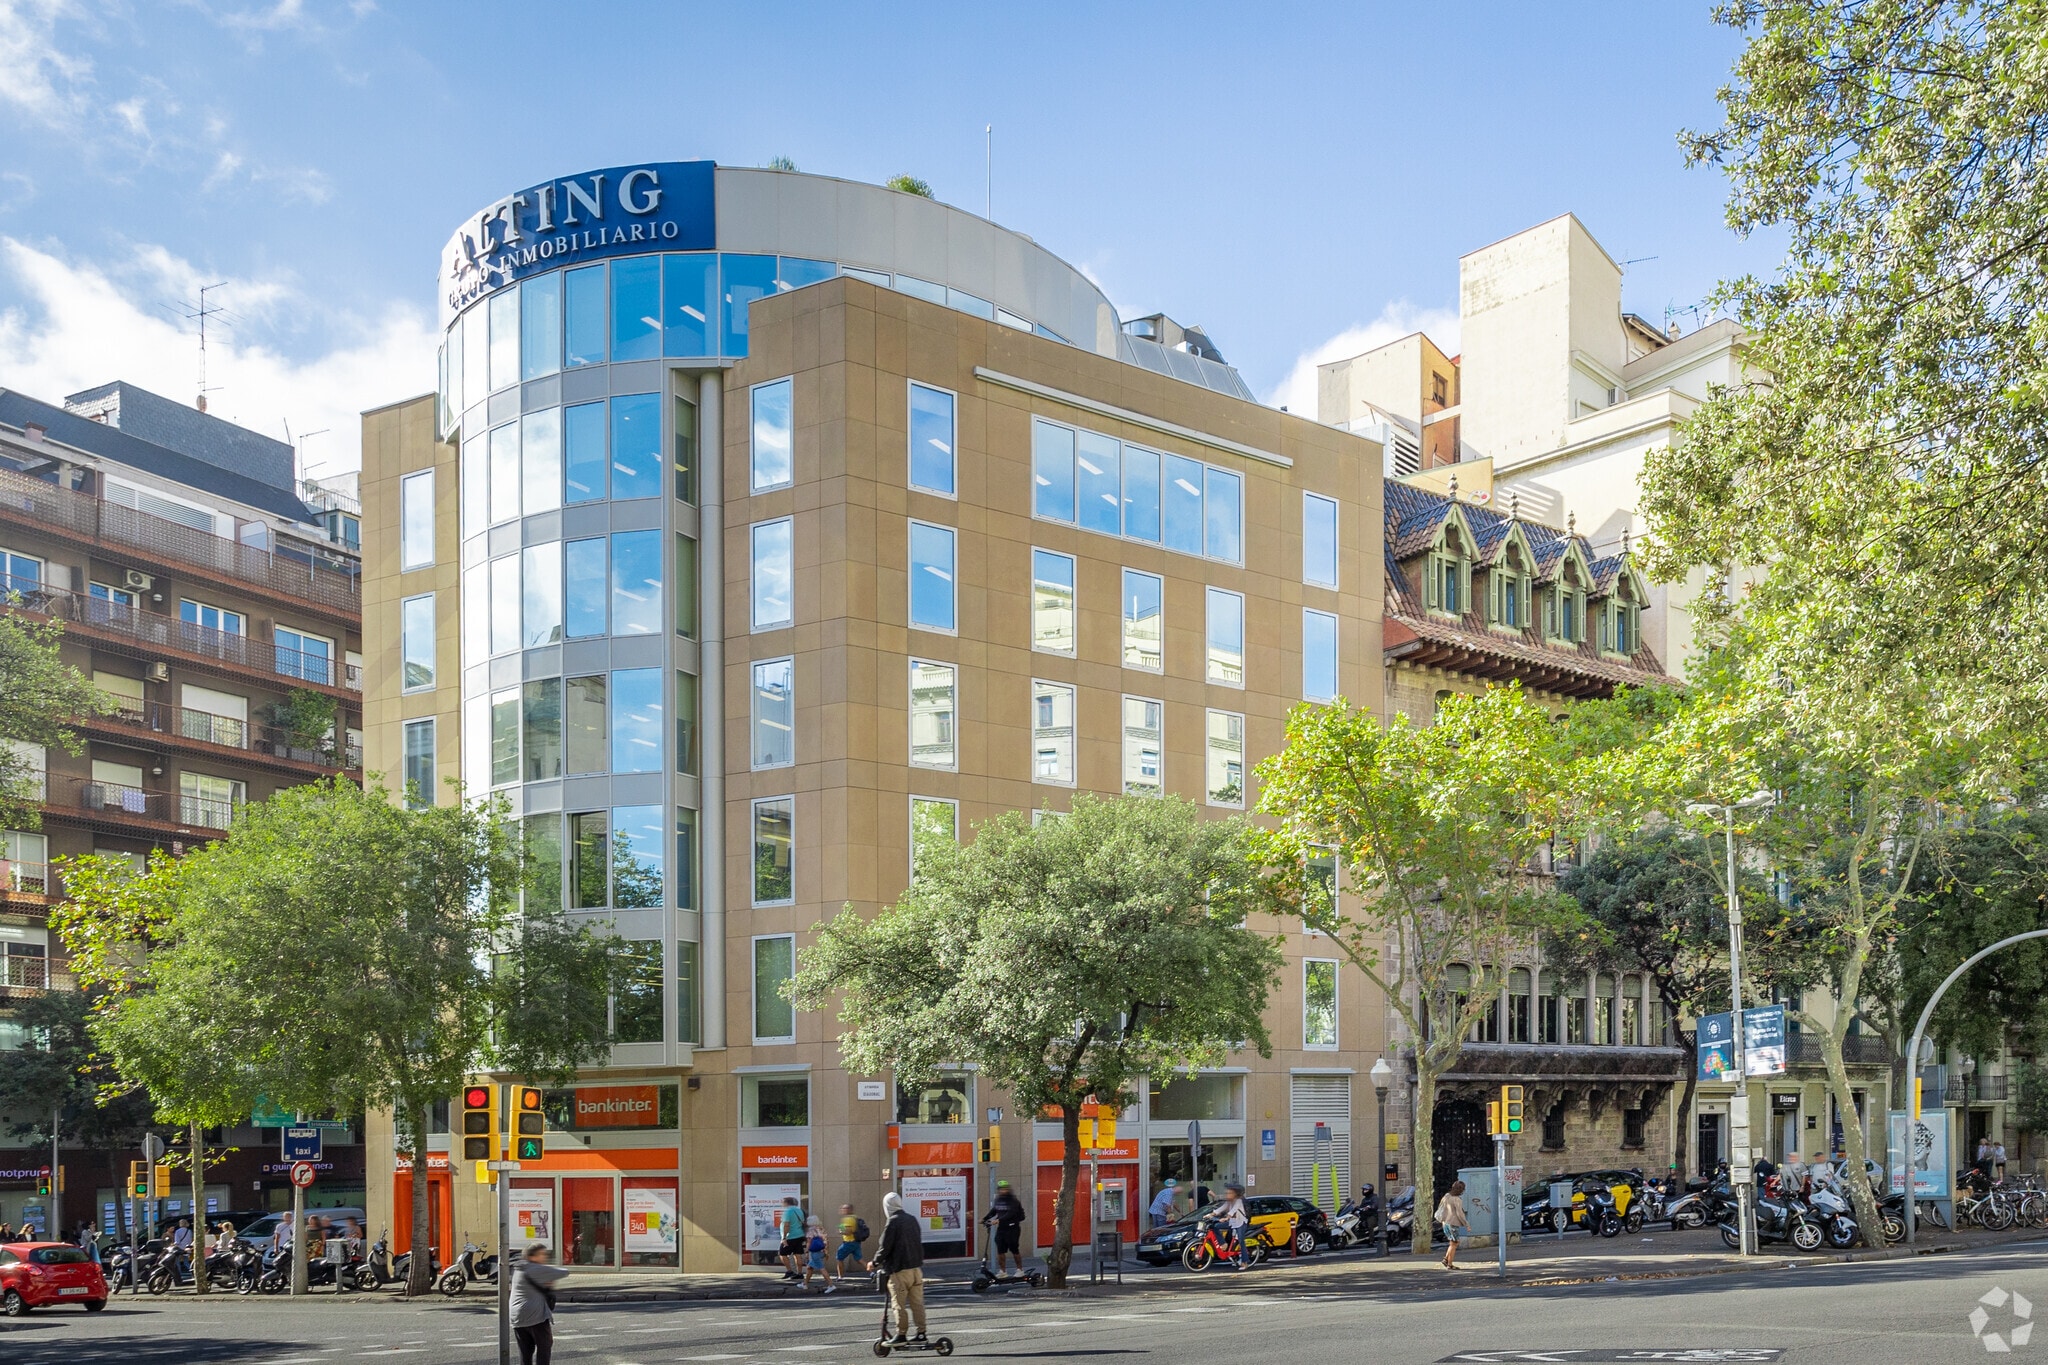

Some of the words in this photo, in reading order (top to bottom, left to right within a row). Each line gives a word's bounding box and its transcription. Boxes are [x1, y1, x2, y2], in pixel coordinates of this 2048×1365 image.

[450, 169, 662, 279] ALTING
[499, 221, 679, 274] INMOBILIARIO
[295, 1147, 311, 1155] taxi
